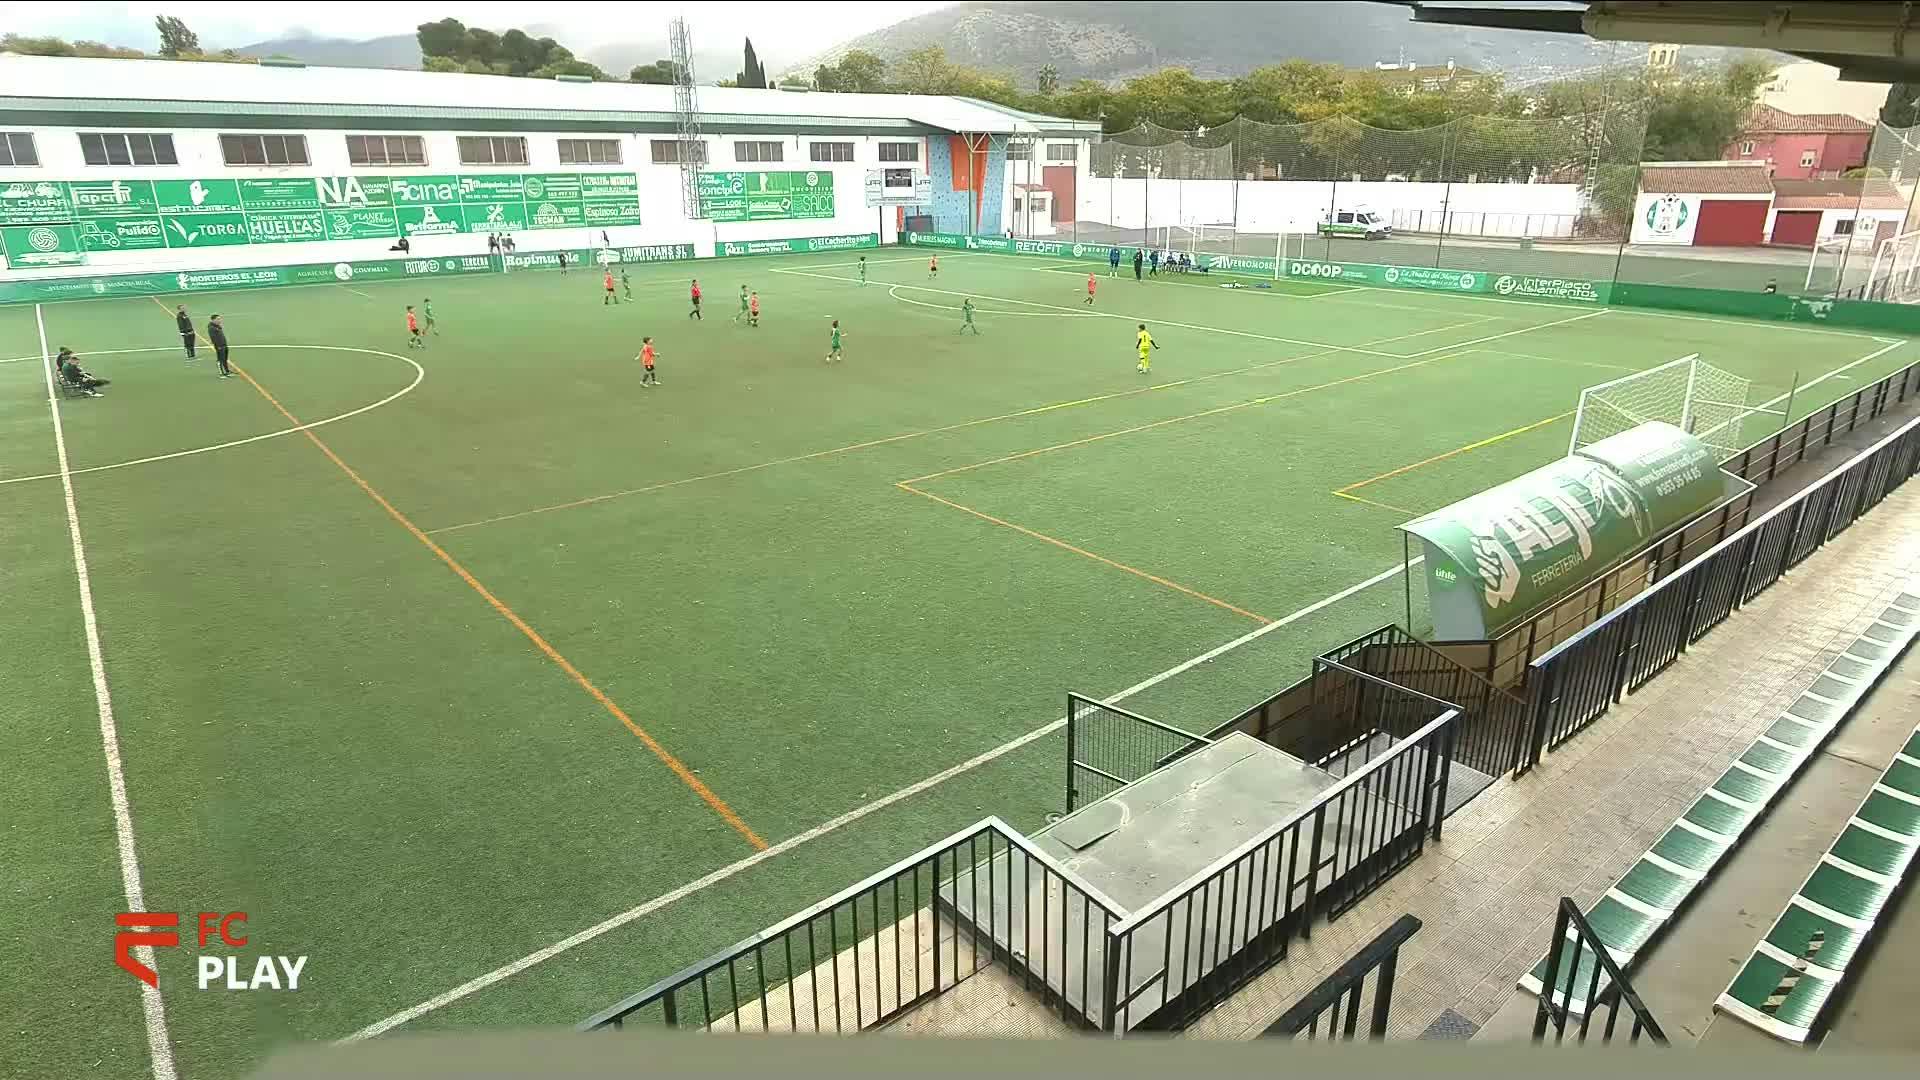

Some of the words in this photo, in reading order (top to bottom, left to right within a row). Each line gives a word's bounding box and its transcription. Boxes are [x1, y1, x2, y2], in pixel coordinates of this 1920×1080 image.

[315, 177, 369, 204] NA
[199, 223, 246, 236] TORGA
[250, 219, 323, 236] HUELLAS
[622, 246, 674, 258] JUMITRANS
[189, 273, 240, 282] MORTEROS
[240, 272, 253, 280] EL
[1291, 261, 1343, 279] DCOOP
[1530, 550, 1585, 589] FERRETERIA
